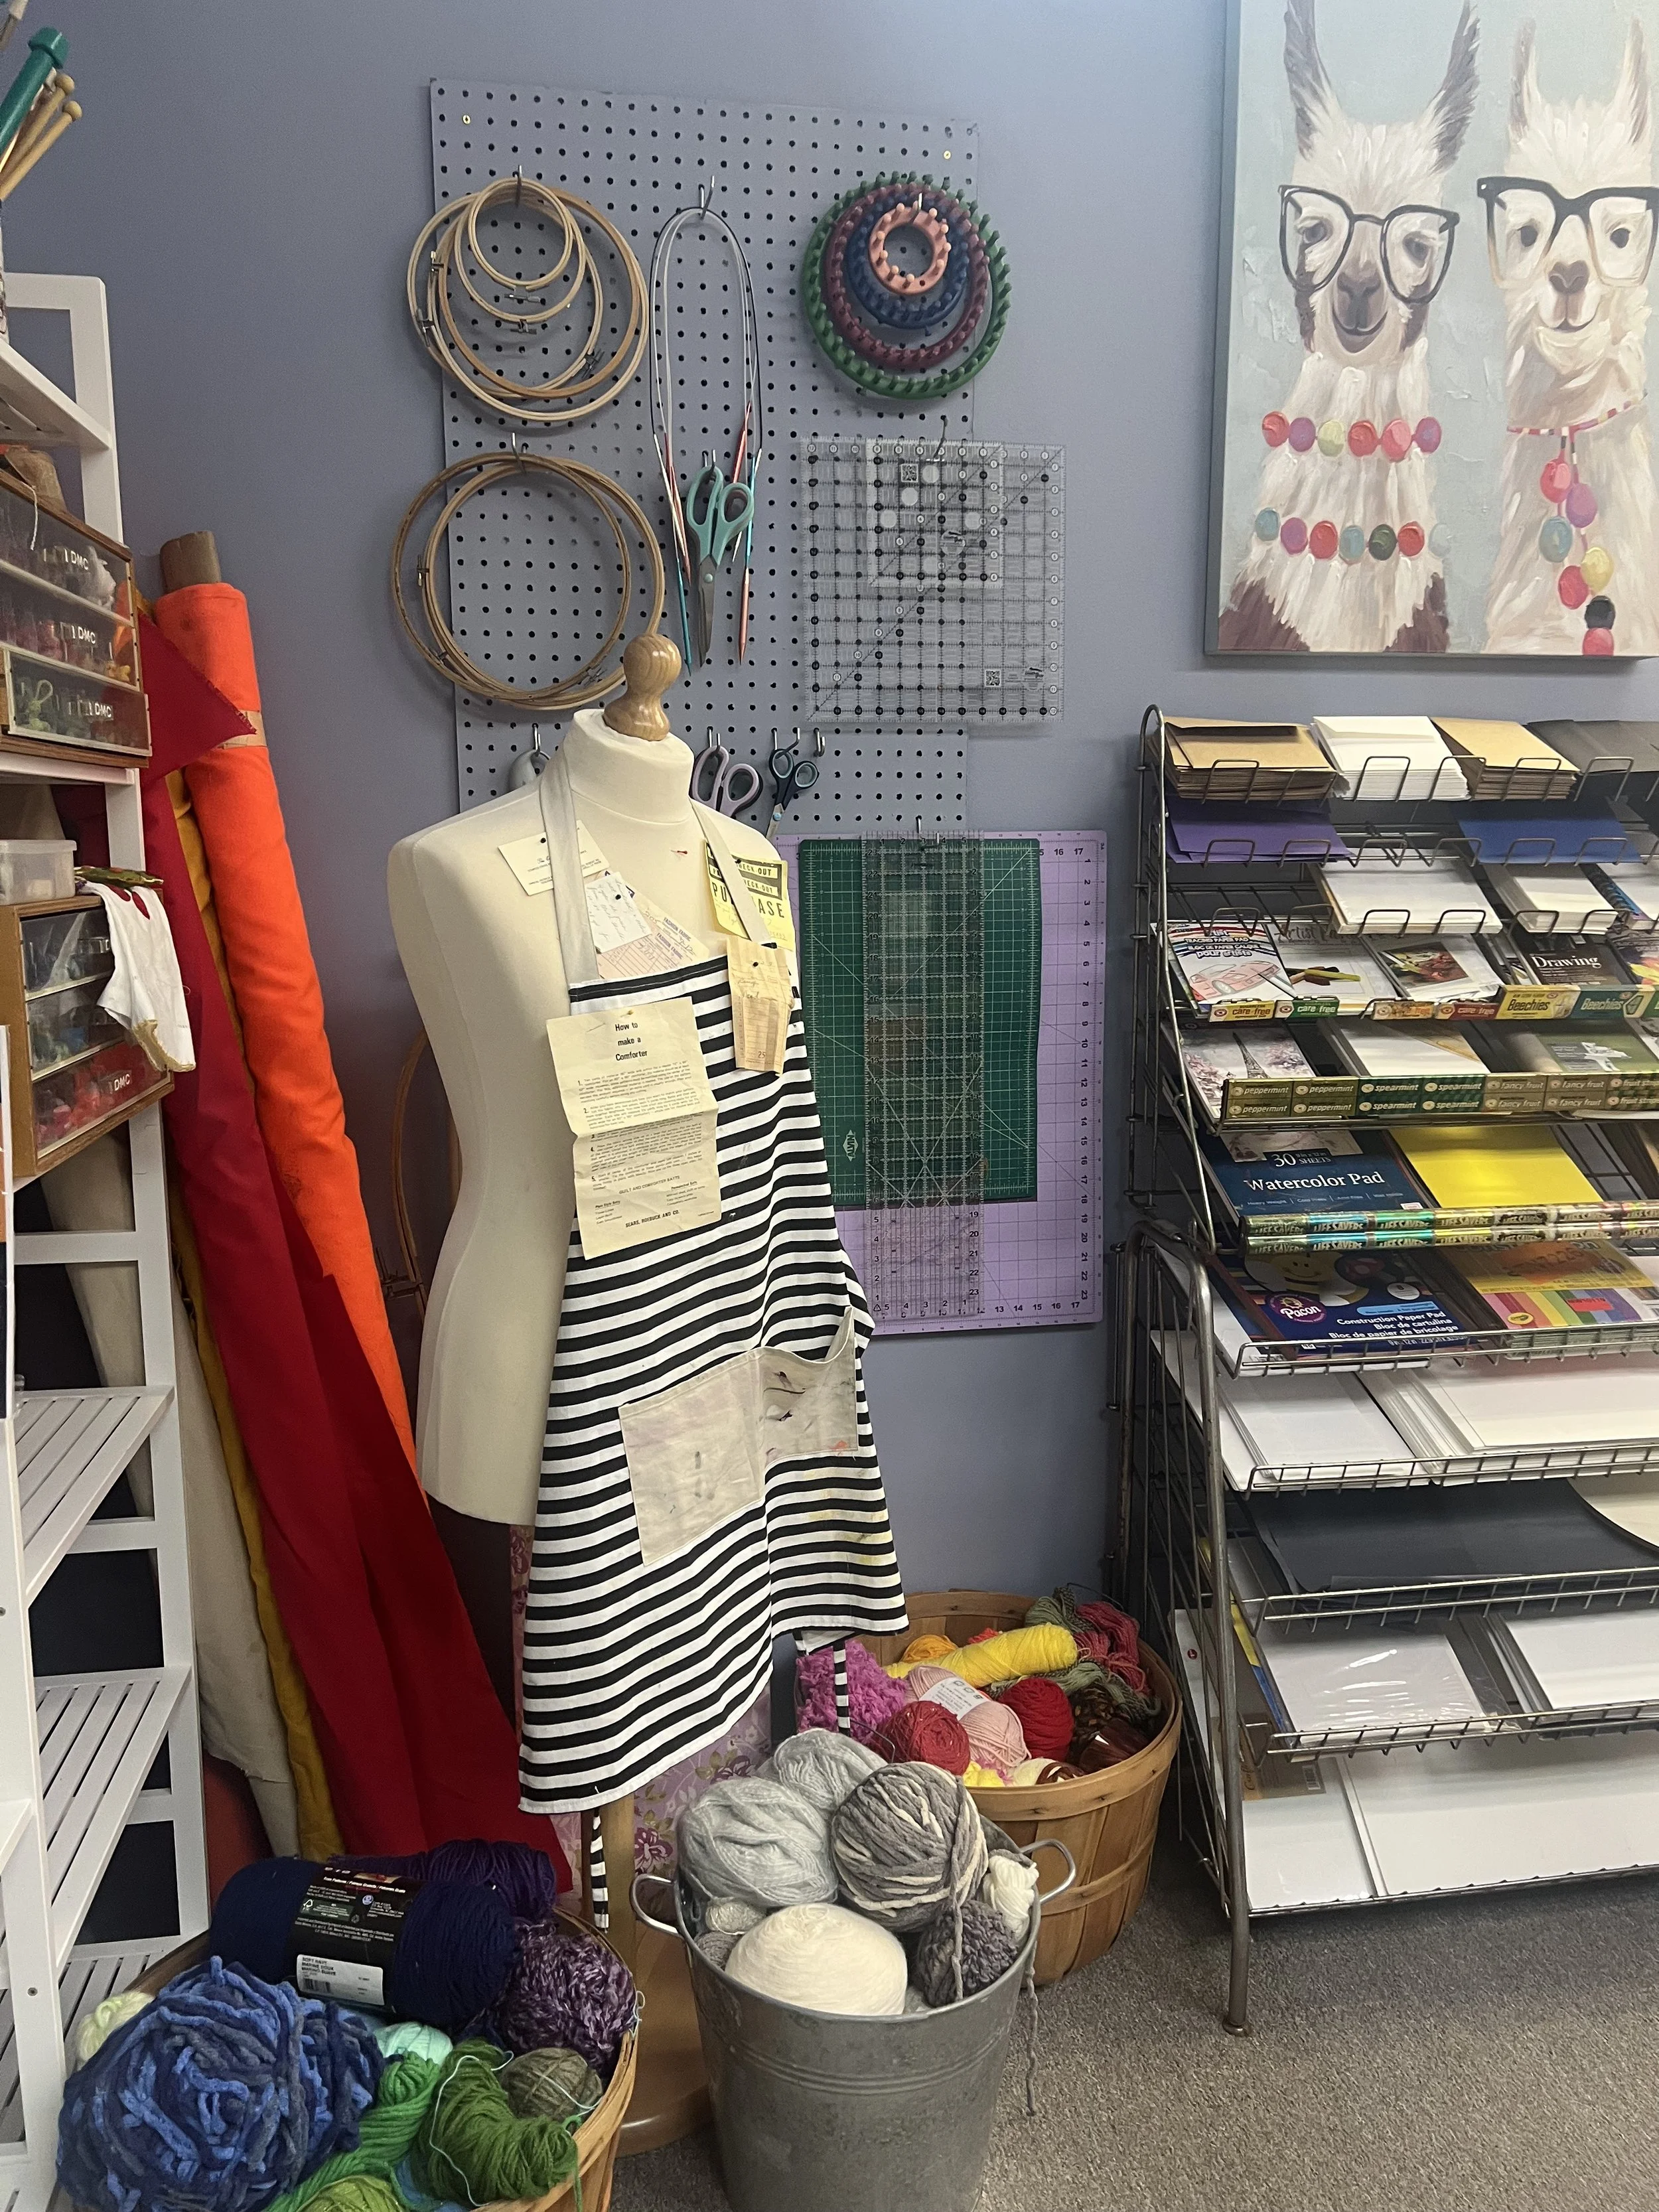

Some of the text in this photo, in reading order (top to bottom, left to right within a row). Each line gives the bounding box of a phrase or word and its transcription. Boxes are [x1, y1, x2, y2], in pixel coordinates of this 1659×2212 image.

[71, 550, 89, 570] DMC
[78, 626, 96, 644] DMC
[95, 703, 112, 718] DMC
[712, 881, 785, 919] PUASE
[664, 917, 678, 932] FASHION
[656, 932, 672, 948] FASHION
[1532, 956, 1602, 969] Drawing
[1507, 999, 1551, 1011] Beechies
[1581, 997, 1624, 1010] Beechies
[614, 1023, 630, 1031] How
[618, 1037, 634, 1046] make
[1082, 1039, 1088, 1049] 10
[615, 1051, 648, 1061] Comforter
[1081, 1059, 1088, 1068] 11
[114, 1073, 130, 1091] DMC
[1081, 1078, 1088, 1087] 12
[1438, 1082, 1482, 1092] spearmint
[1500, 1082, 1524, 1090] fancy
[1562, 1080, 1585, 1089] fancy
[1244, 1086, 1289, 1095] peppermint
[1309, 1085, 1354, 1094] peppermint
[1374, 1084, 1419, 1092] spearmint
[1081, 1097, 1088, 1107] 13
[1372, 1102, 1417, 1110] spearmint
[1559, 1099, 1582, 1108] fancy
[1081, 1117, 1088, 1126] 14
[847, 1134, 855, 1157] ALVIN
[1081, 1136, 1088, 1146] 15
[1081, 1155, 1088, 1165] 16
[1271, 1153, 1296, 1167] 30
[1081, 1175, 1088, 1184] 17
[1244, 1171, 1386, 1191] Watercolor Pad
[1081, 1195, 1088, 1204] 18
[641, 1214, 661, 1224] ROEBUCK
[1081, 1214, 1088, 1223] 19
[1314, 1220, 1363, 1232] LIFE SAVERS
[1081, 1232, 1088, 1242] 20
[1313, 1240, 1362, 1251] LIFE SAVERS
[1082, 1252, 1088, 1262] 21
[1082, 1271, 1088, 1281] 22
[1082, 1290, 1088, 1300] 23
[1281, 1305, 1321, 1319] Pacon
[1336, 1316, 1397, 1325] Construction
[1412, 1318, 1453, 1327] cartulina
[1415, 1325, 1459, 1334] bricolage
